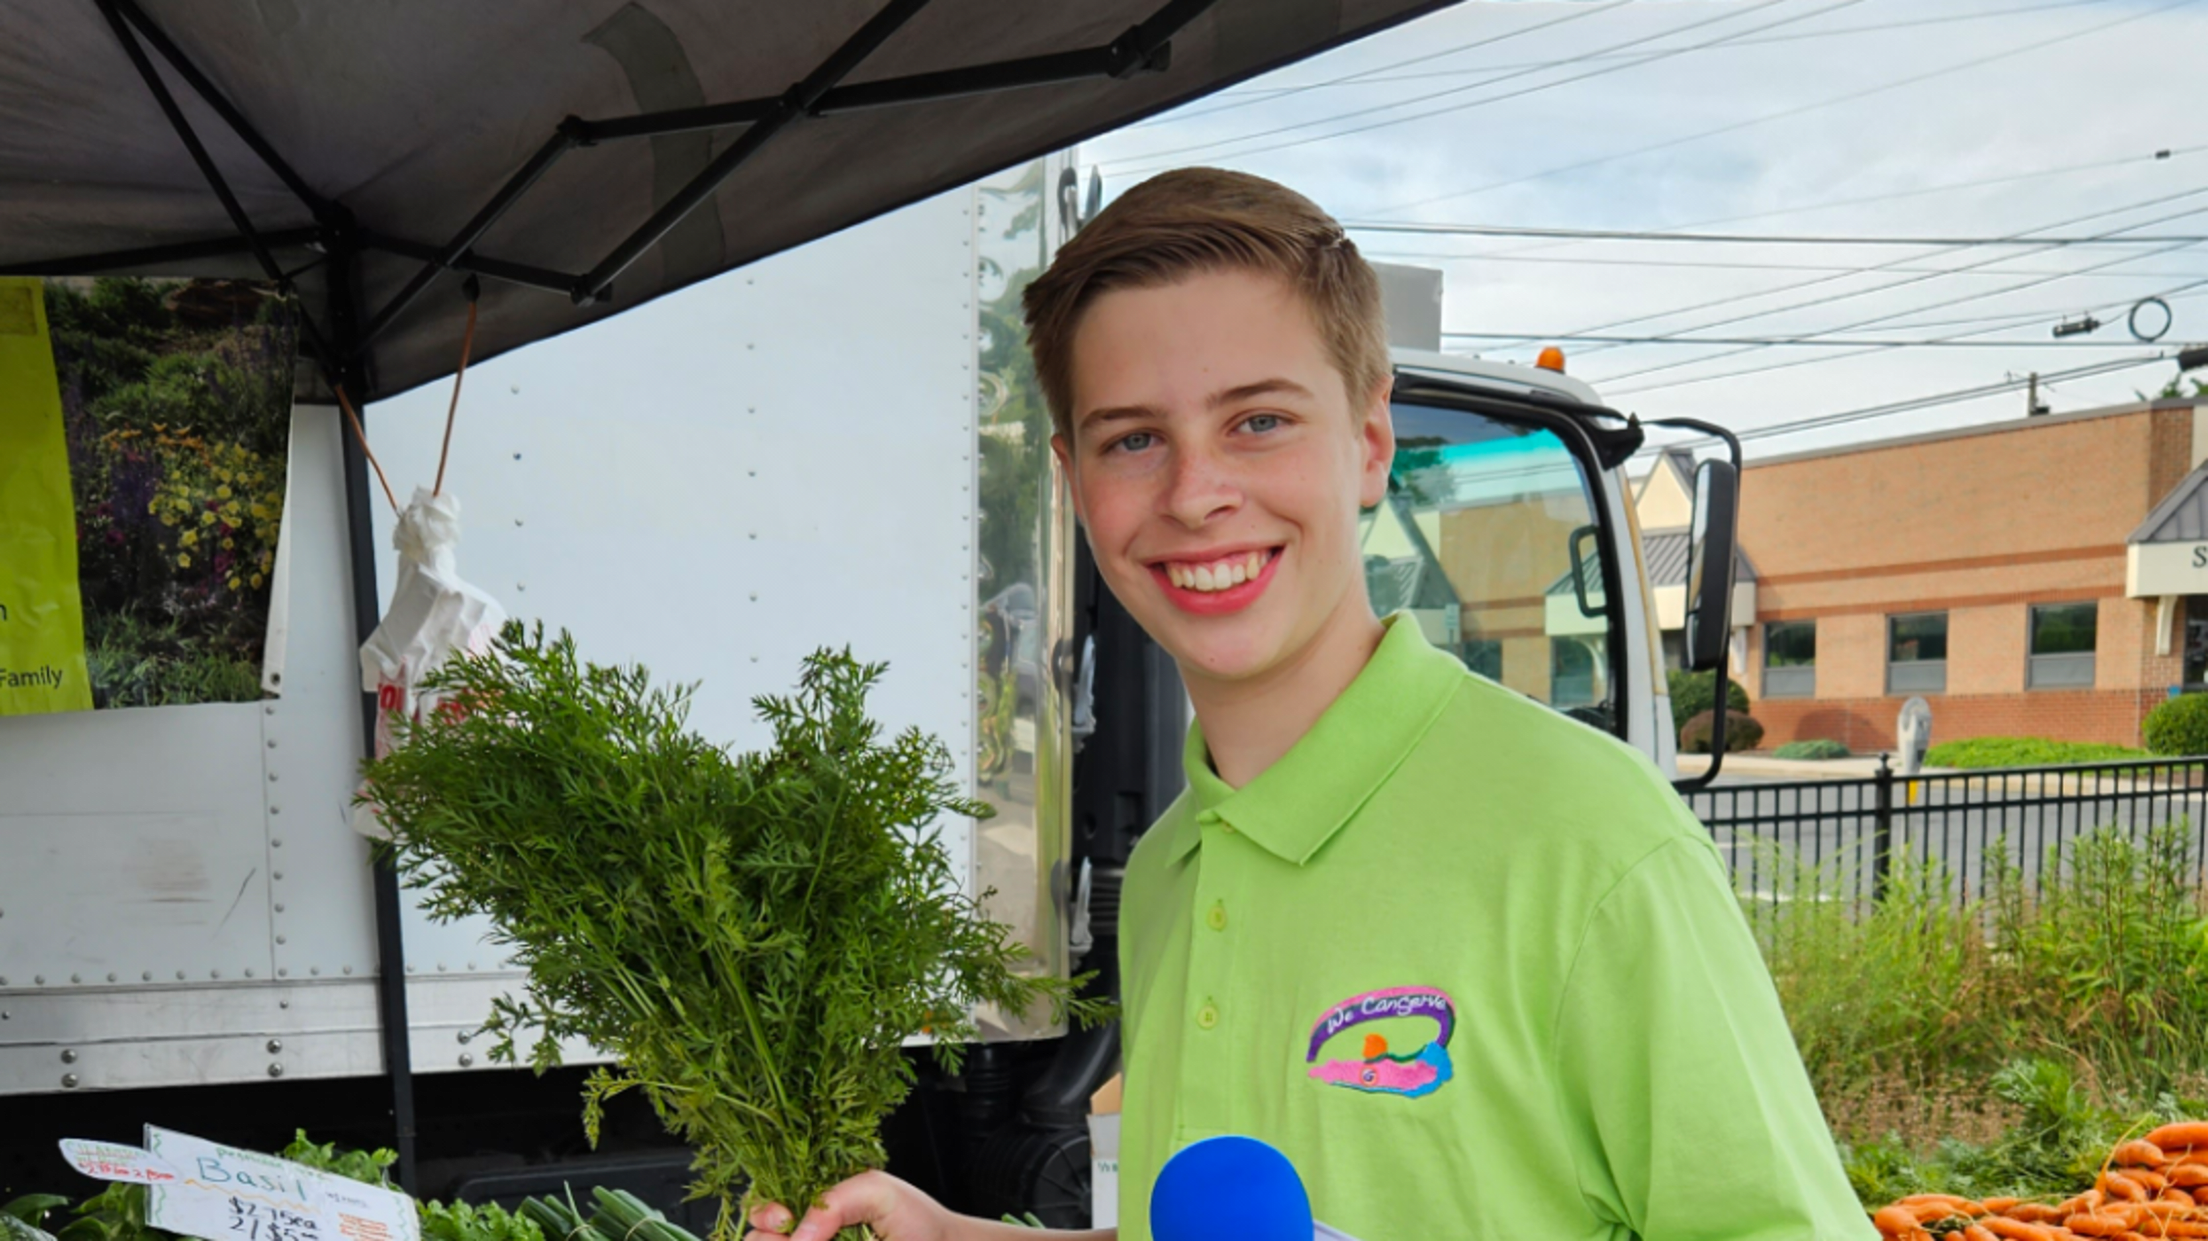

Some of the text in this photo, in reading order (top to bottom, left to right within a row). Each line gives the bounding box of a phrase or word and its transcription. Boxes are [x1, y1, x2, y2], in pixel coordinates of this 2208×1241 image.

[0, 665, 62, 690] Family
[1327, 1008, 1354, 1034] We
[196, 1156, 307, 1202] Basil
